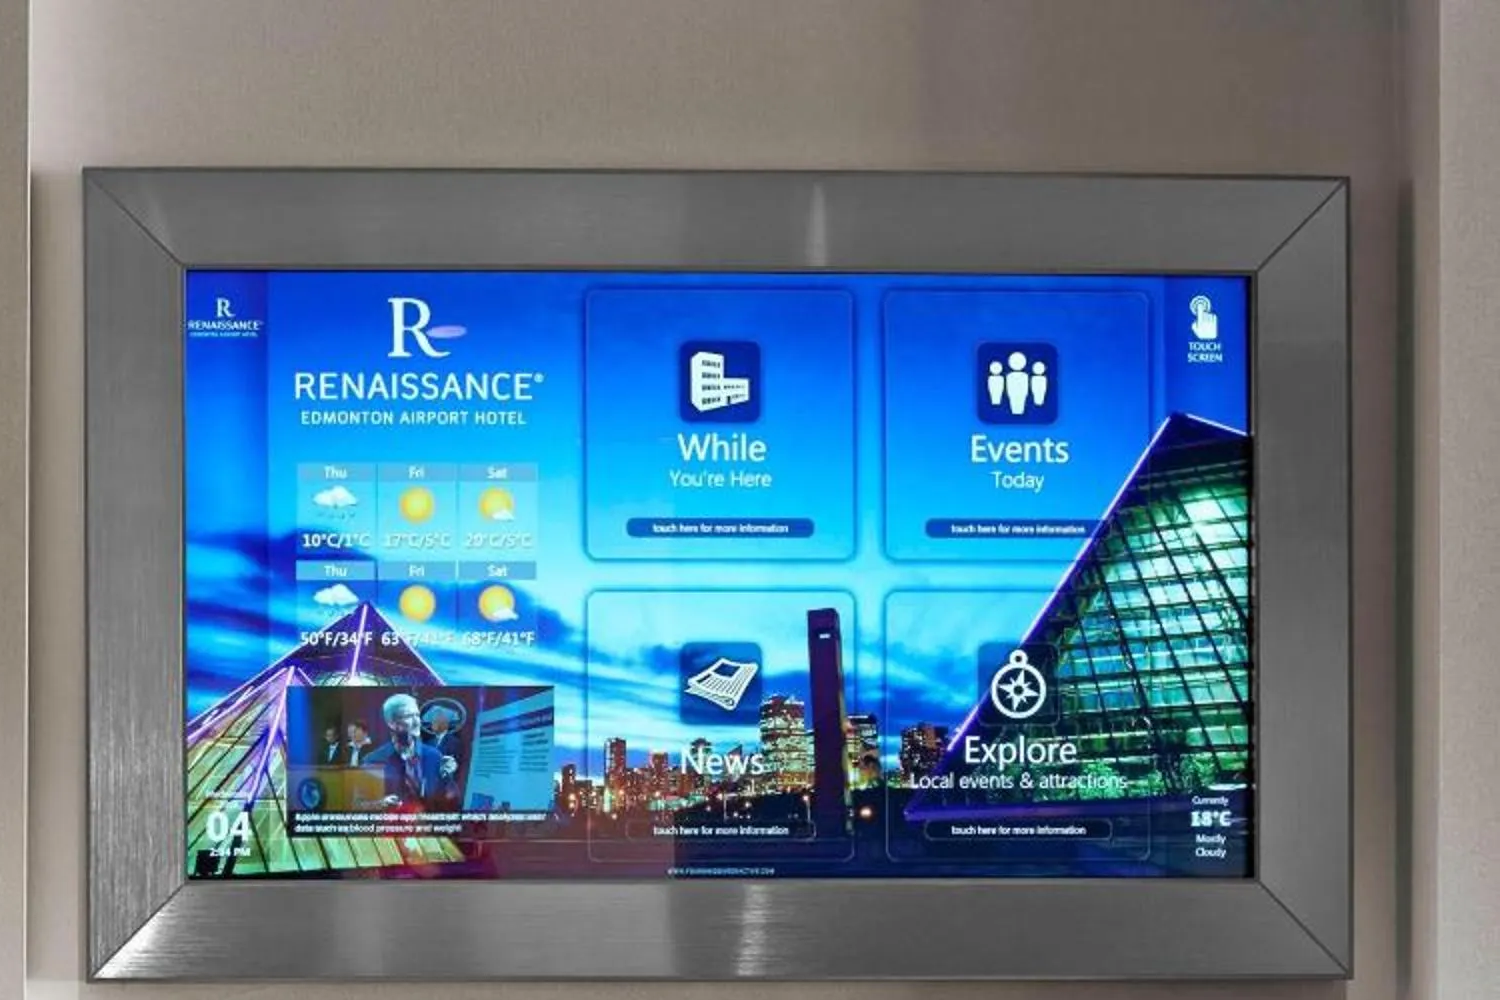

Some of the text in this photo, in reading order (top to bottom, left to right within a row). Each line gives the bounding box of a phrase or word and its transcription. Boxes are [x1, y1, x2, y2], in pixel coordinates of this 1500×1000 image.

[216, 297, 236, 318] R
[387, 297, 451, 358] R
[1188, 341, 1221, 351] TOUCH
[1187, 352, 1223, 363] SCREEN
[301, 410, 527, 425] EDMONTON AIRPORT HOTEL
[677, 432, 767, 462] While
[970, 434, 1070, 464] Events
[323, 466, 348, 479] Thu
[408, 466, 425, 479] Fri
[487, 467, 508, 479] Sat
[669, 469, 773, 488] You're Here
[991, 471, 1045, 494] Today
[653, 523, 678, 533] touch
[679, 523, 699, 533] here
[700, 523, 713, 533] for
[739, 523, 789, 533] information
[323, 564, 348, 577] Thu
[408, 564, 425, 577] Fri
[487, 565, 508, 577] Sat
[964, 735, 1078, 771] Explore
[680, 751, 766, 775] News
[910, 772, 1130, 790] Local events & attractions
[206, 810, 251, 842] 04
[653, 825, 789, 835] touch here for more information
[951, 825, 1087, 835] touch here for more information
[1195, 847, 1227, 858] Cloudy
